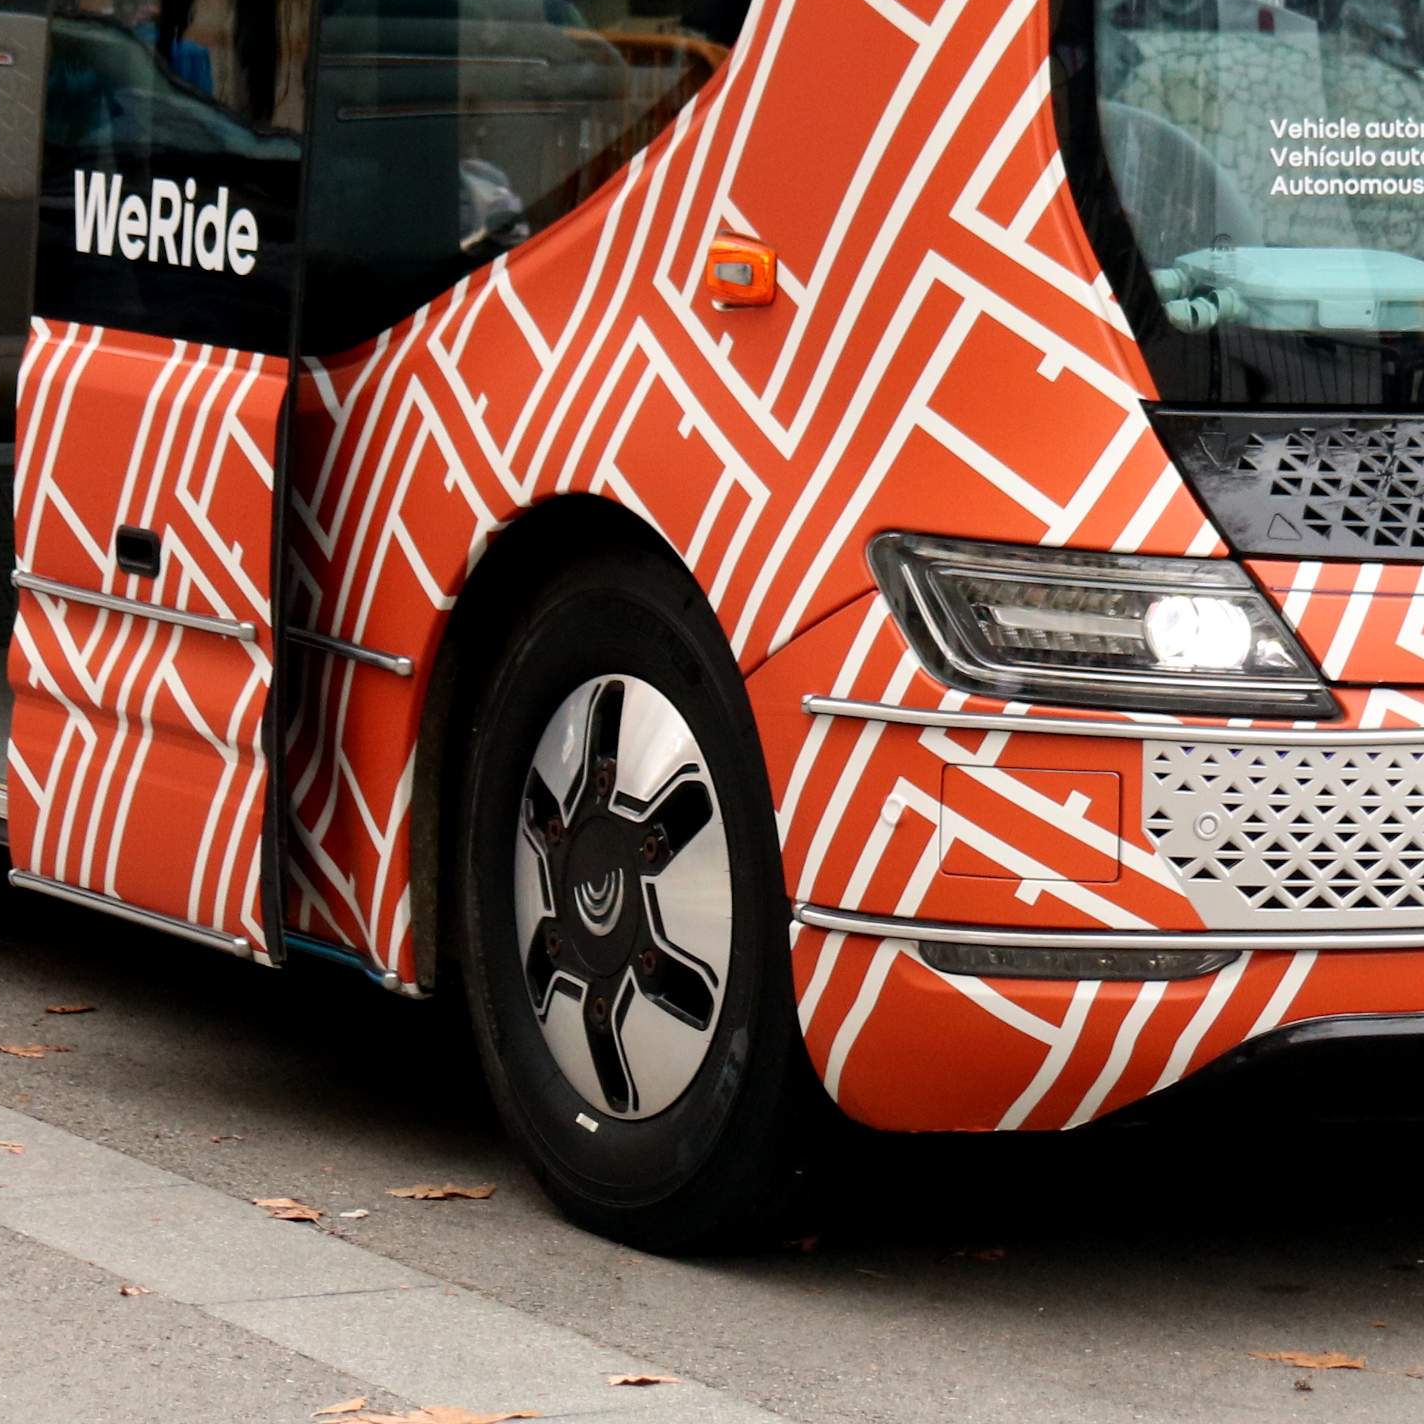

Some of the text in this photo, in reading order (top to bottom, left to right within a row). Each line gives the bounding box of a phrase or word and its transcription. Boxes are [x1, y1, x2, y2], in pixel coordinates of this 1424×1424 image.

[1270, 117, 1360, 139] Vehicle
[1270, 145, 1376, 168] Vehículo
[1270, 176, 1424, 196] Autonomous
[74, 168, 259, 276] WeRide
